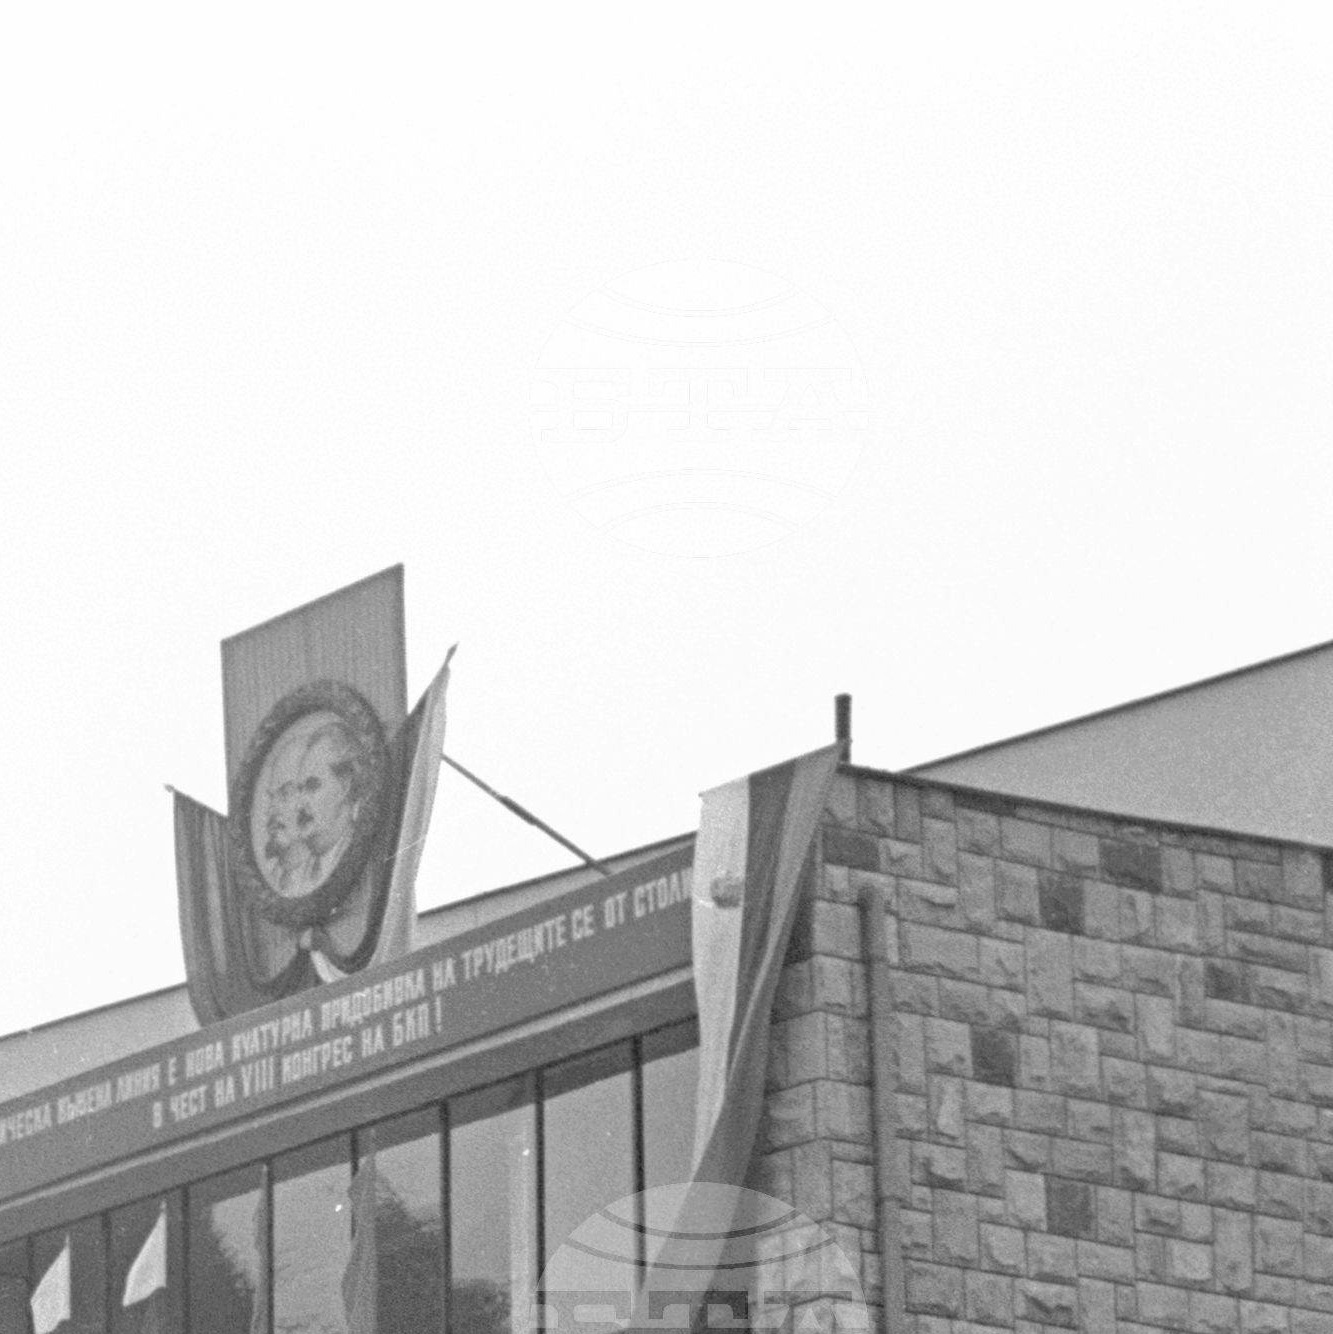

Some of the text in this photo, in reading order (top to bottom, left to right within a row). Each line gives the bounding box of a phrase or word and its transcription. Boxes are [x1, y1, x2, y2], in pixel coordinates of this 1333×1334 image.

[168, 1057, 177, 1086] Е
[186, 1041, 224, 1080] НОВА
[232, 1009, 313, 1062] КУЛТУРНА
[321, 968, 425, 1031] ПРИДОБИВКА
[433, 958, 456, 991] НА
[462, 915, 566, 980] ТРУДЕЩИТЕ
[571, 904, 594, 941] СЕ
[604, 891, 627, 928] ОТ
[170, 1085, 207, 1122] ЧЕСТ
[215, 1075, 234, 1108] НА
[241, 1056, 274, 1098] VIII
[283, 1035, 352, 1084] КОНГРЕС
[362, 1024, 384, 1058] НА
